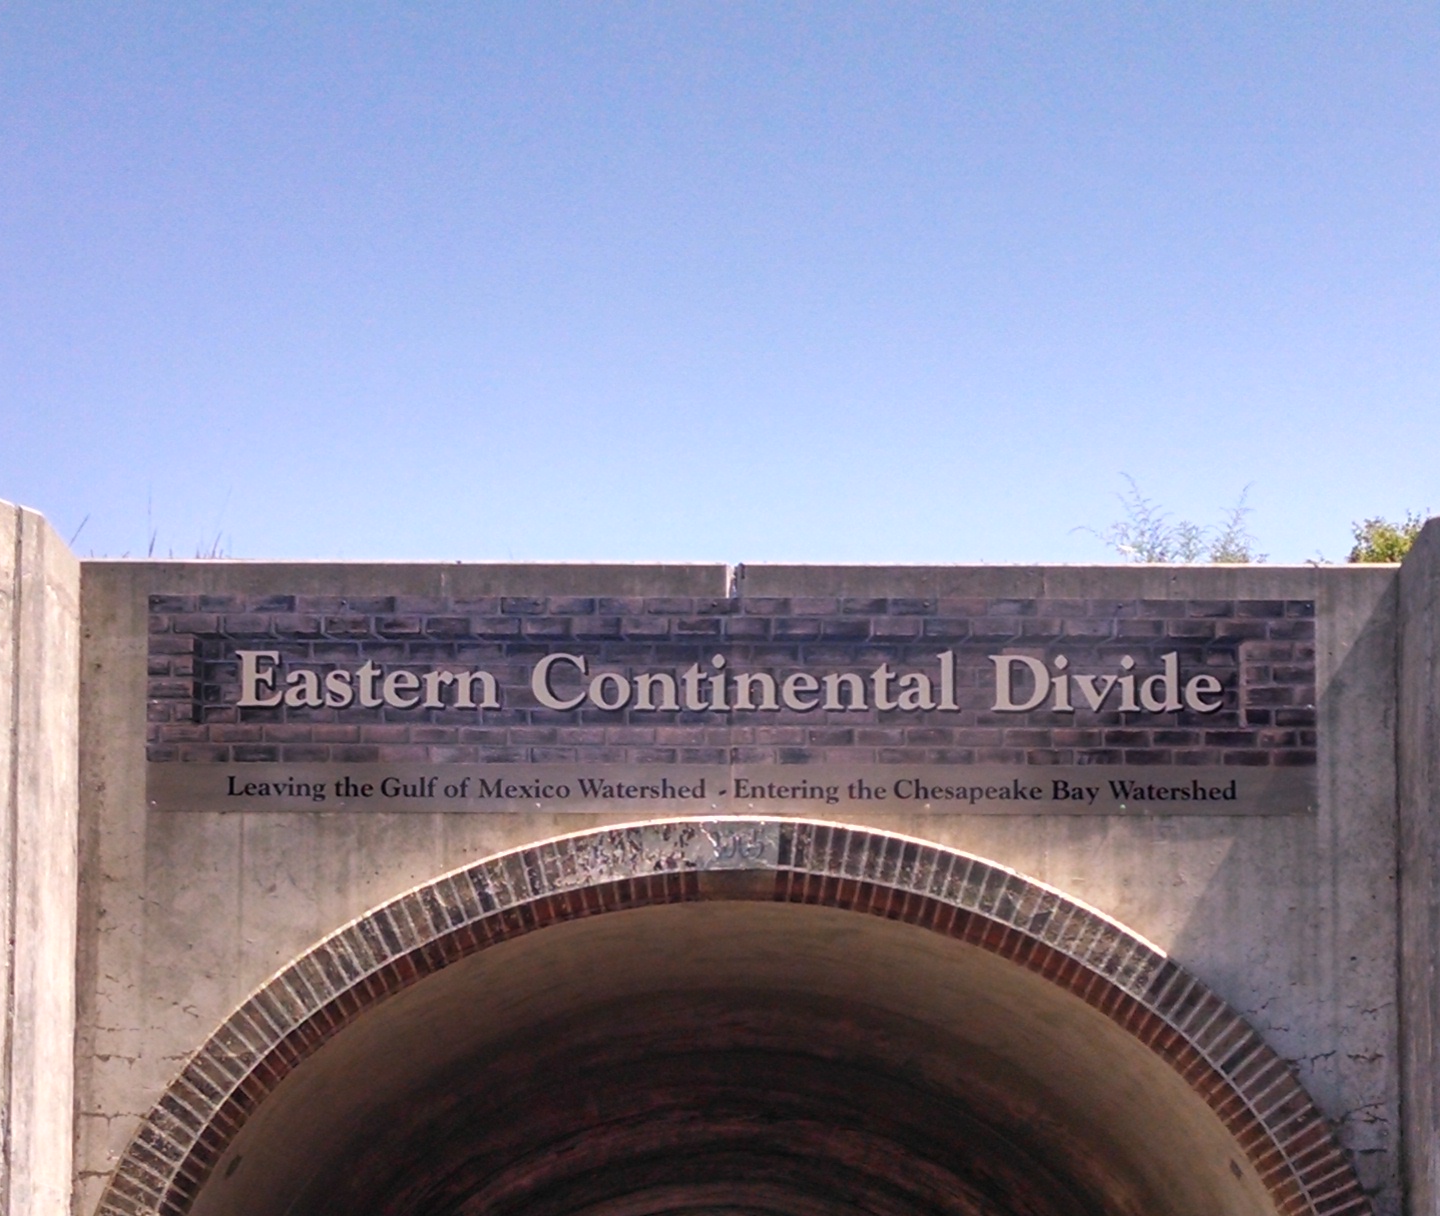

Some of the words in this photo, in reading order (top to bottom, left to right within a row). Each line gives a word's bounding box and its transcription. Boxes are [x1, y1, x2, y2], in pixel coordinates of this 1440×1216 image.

[235, 649, 500, 709] Eastern
[531, 649, 960, 712] Continental
[988, 650, 1223, 713] Divide
[227, 775, 326, 801] Leaving
[334, 776, 374, 799] the
[380, 776, 438, 799] Gulf
[444, 776, 472, 799] of
[479, 778, 571, 800] Mexico
[578, 777, 706, 800] Watershed
[733, 778, 840, 803] Entering
[847, 778, 887, 801] the
[893, 777, 1043, 803] Chesapeake
[1051, 779, 1101, 803] Bay
[1109, 779, 1237, 801] Watershed
